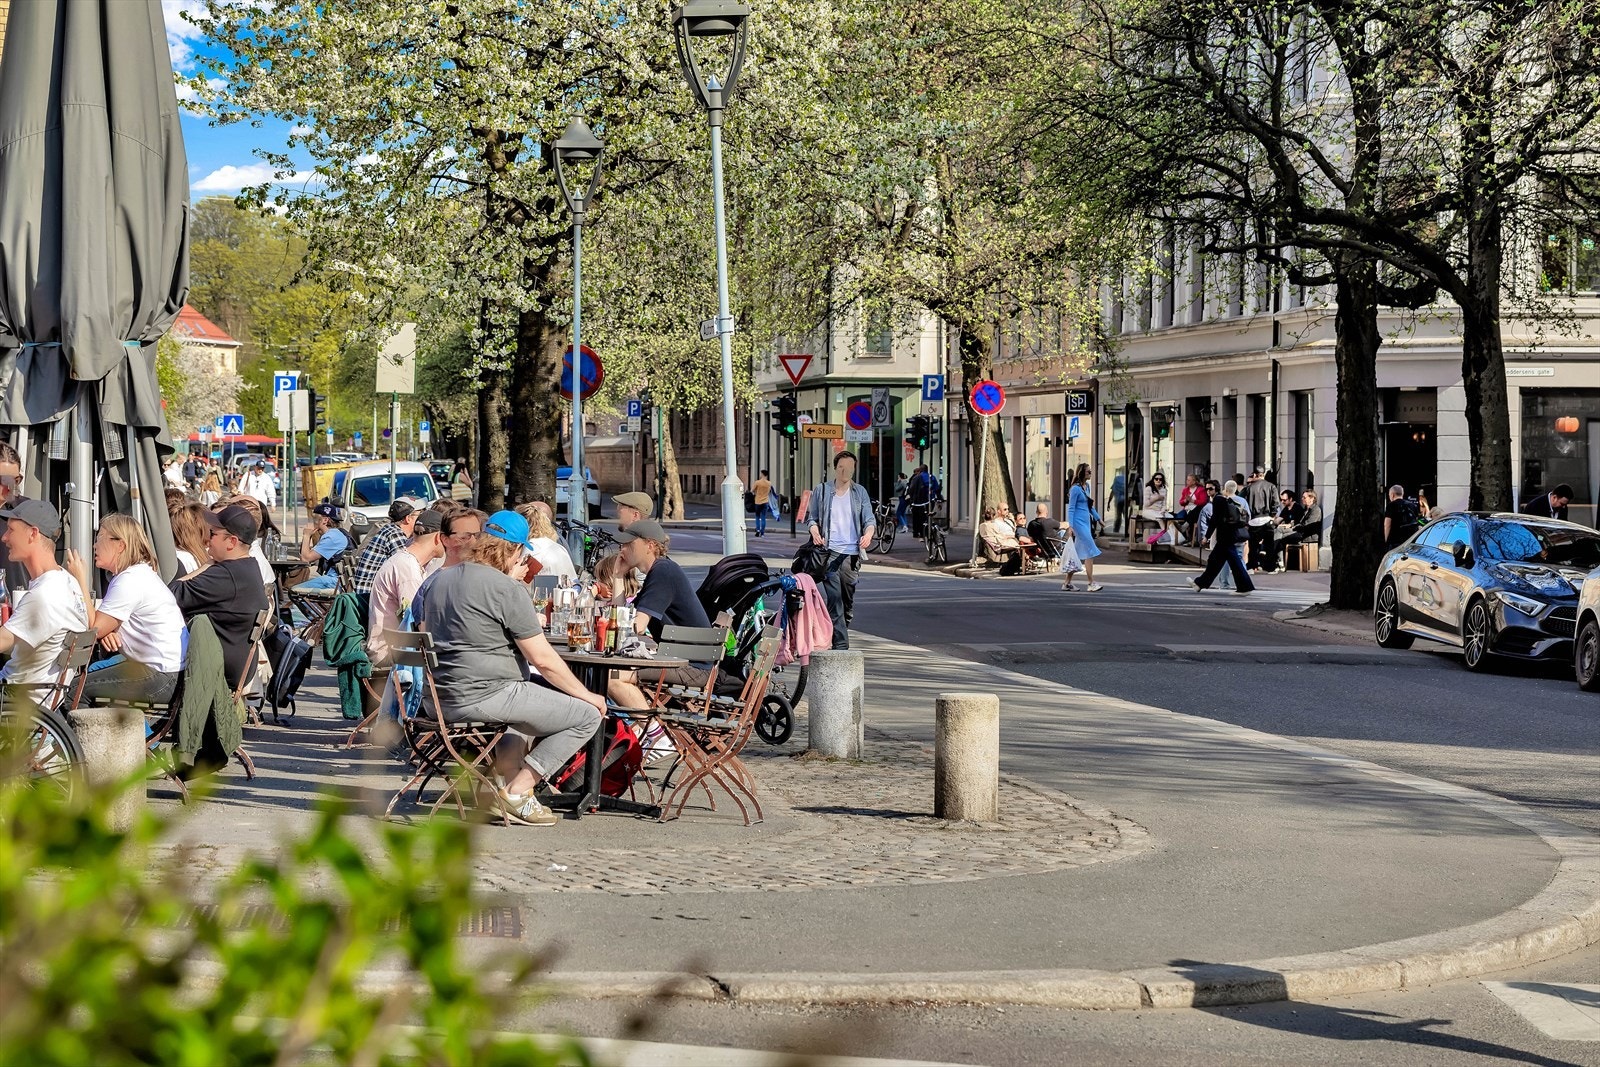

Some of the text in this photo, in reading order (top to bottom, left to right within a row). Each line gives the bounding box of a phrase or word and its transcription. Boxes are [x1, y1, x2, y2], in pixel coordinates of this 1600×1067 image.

[279, 378, 292, 391] P
[927, 378, 940, 398] P
[630, 402, 639, 415] P
[1071, 397, 1084, 408] SP
[818, 427, 837, 435] Storo
